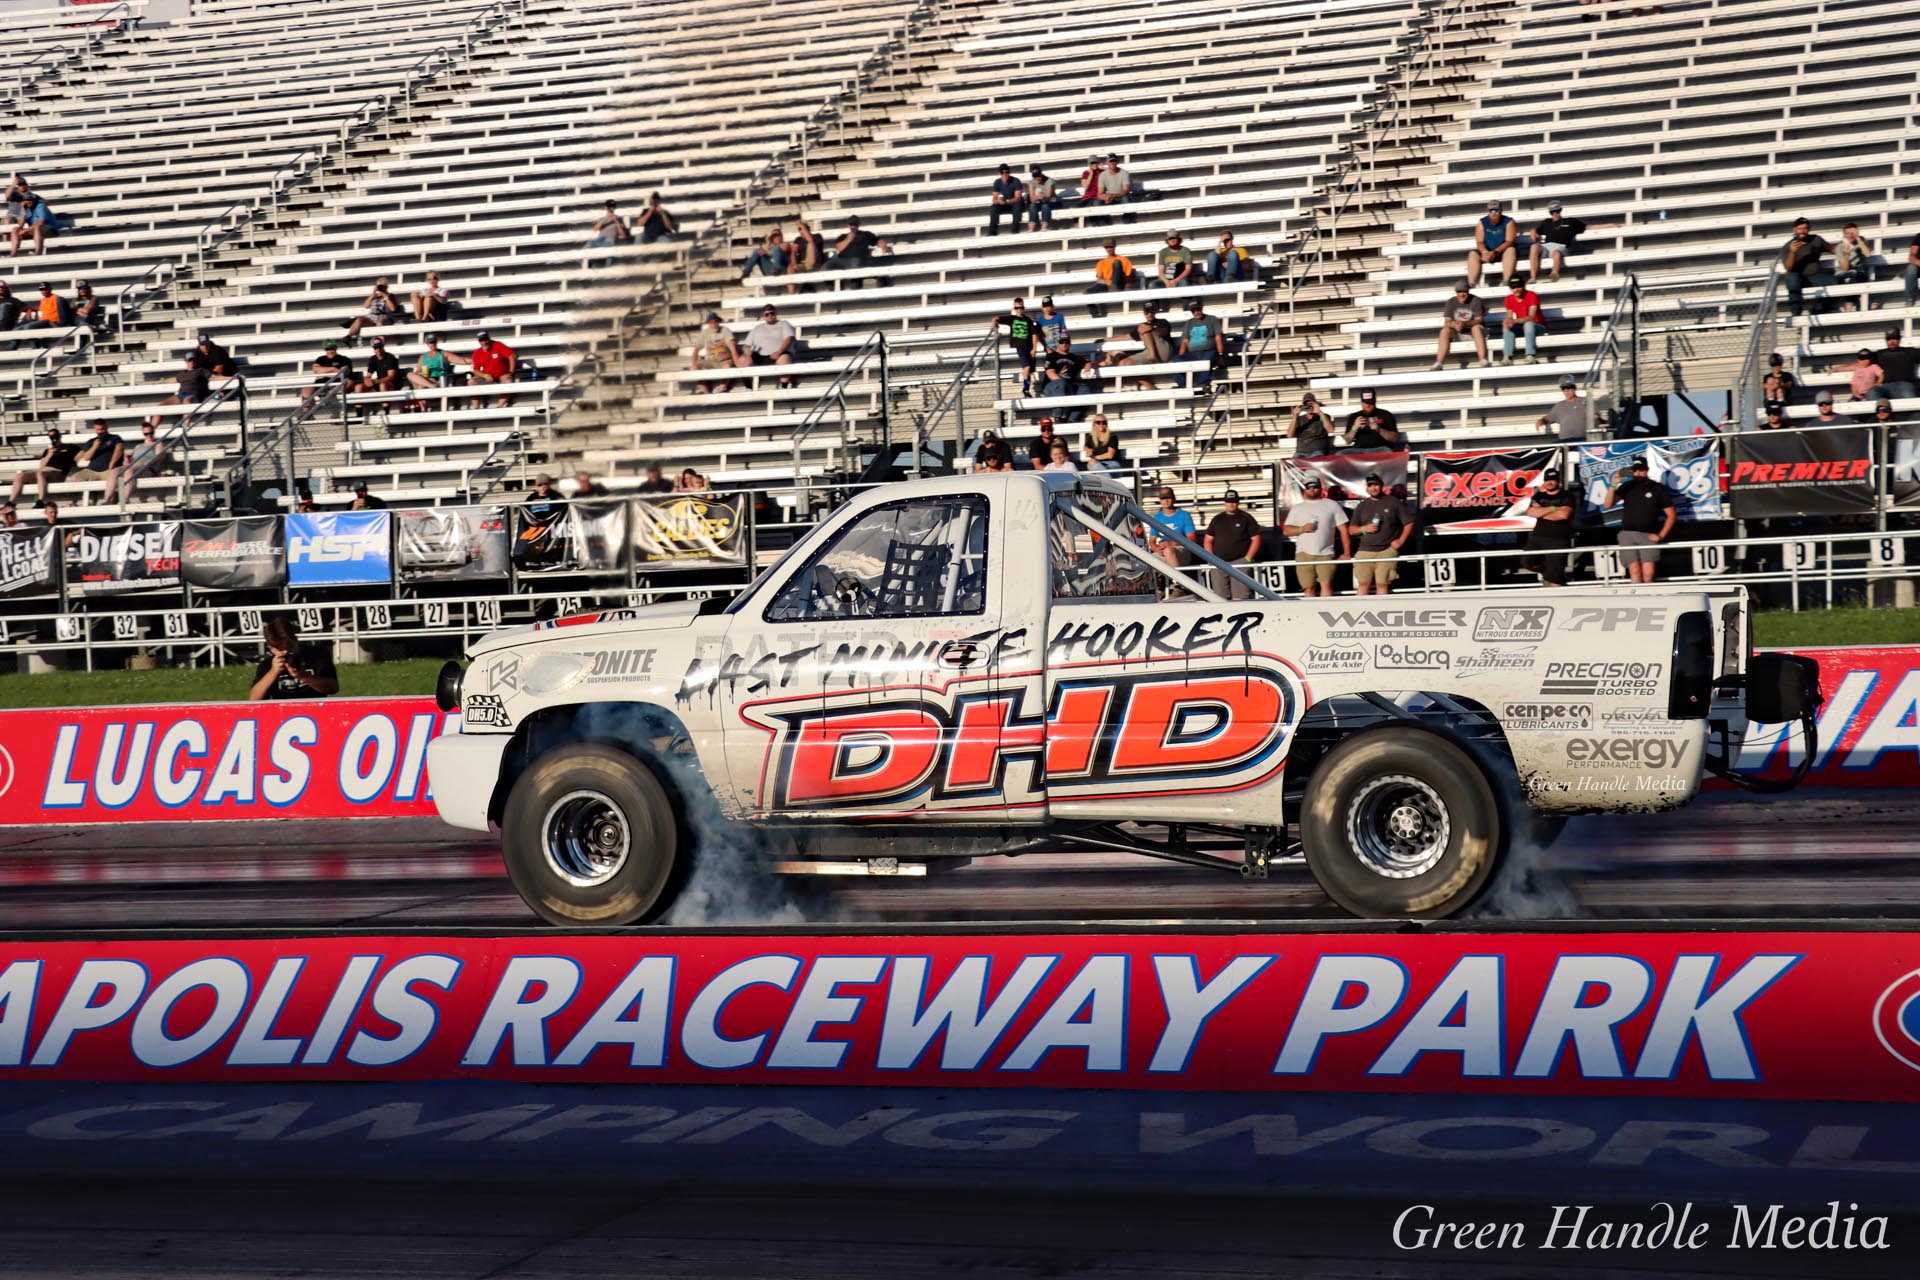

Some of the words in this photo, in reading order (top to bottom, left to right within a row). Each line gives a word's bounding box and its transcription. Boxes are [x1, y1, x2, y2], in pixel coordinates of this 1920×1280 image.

[1732, 459, 1870, 484] PREMIER
[1424, 469, 1547, 503] exerg
[1424, 496, 1508, 508] PERFORMANCE
[82, 532, 180, 563] DIESEL
[288, 534, 387, 563] HSP
[1699, 546, 1716, 569] 10
[1881, 538, 1894, 561] 8
[145, 558, 179, 572] TECH
[1431, 559, 1450, 581] 13
[1262, 566, 1281, 588] 15
[370, 605, 386, 624] 28
[428, 603, 443, 622] 27
[562, 596, 578, 616] 25
[117, 615, 133, 633] 32
[168, 613, 185, 633] 31
[243, 610, 260, 630] 30
[301, 608, 319, 629] 29
[1318, 610, 1467, 628] WAGLER
[1479, 610, 1545, 630] NX
[1560, 608, 1668, 631] PPE
[1402, 630, 1457, 638] PRODUCTS
[675, 642, 823, 705] LAST
[1047, 611, 1265, 662] HOOKER
[1308, 650, 1364, 662] Yukon
[1308, 662, 1331, 670] Gear
[1341, 662, 1363, 670] Axle
[1454, 653, 1535, 667] Shaheen
[587, 675, 620, 684] SUSPENSION
[621, 674, 651, 683] PRODUCTS
[1545, 662, 1662, 679] PRECISION
[1596, 688, 1656, 696] BOOSTED
[1599, 679, 1658, 687] TURBO
[468, 708, 494, 722] DH5.0
[1506, 721, 1579, 729] LUBRICANTS
[766, 666, 1294, 810] DHD
[41, 714, 318, 809] LUCAS
[1566, 738, 1690, 769] exergy
[1566, 759, 1642, 769] PERFORMANCE
[459, 952, 1282, 1074] RACEWAY
[1270, 952, 1808, 1083] PARK
[26, 1100, 1082, 1151] CAMPING
